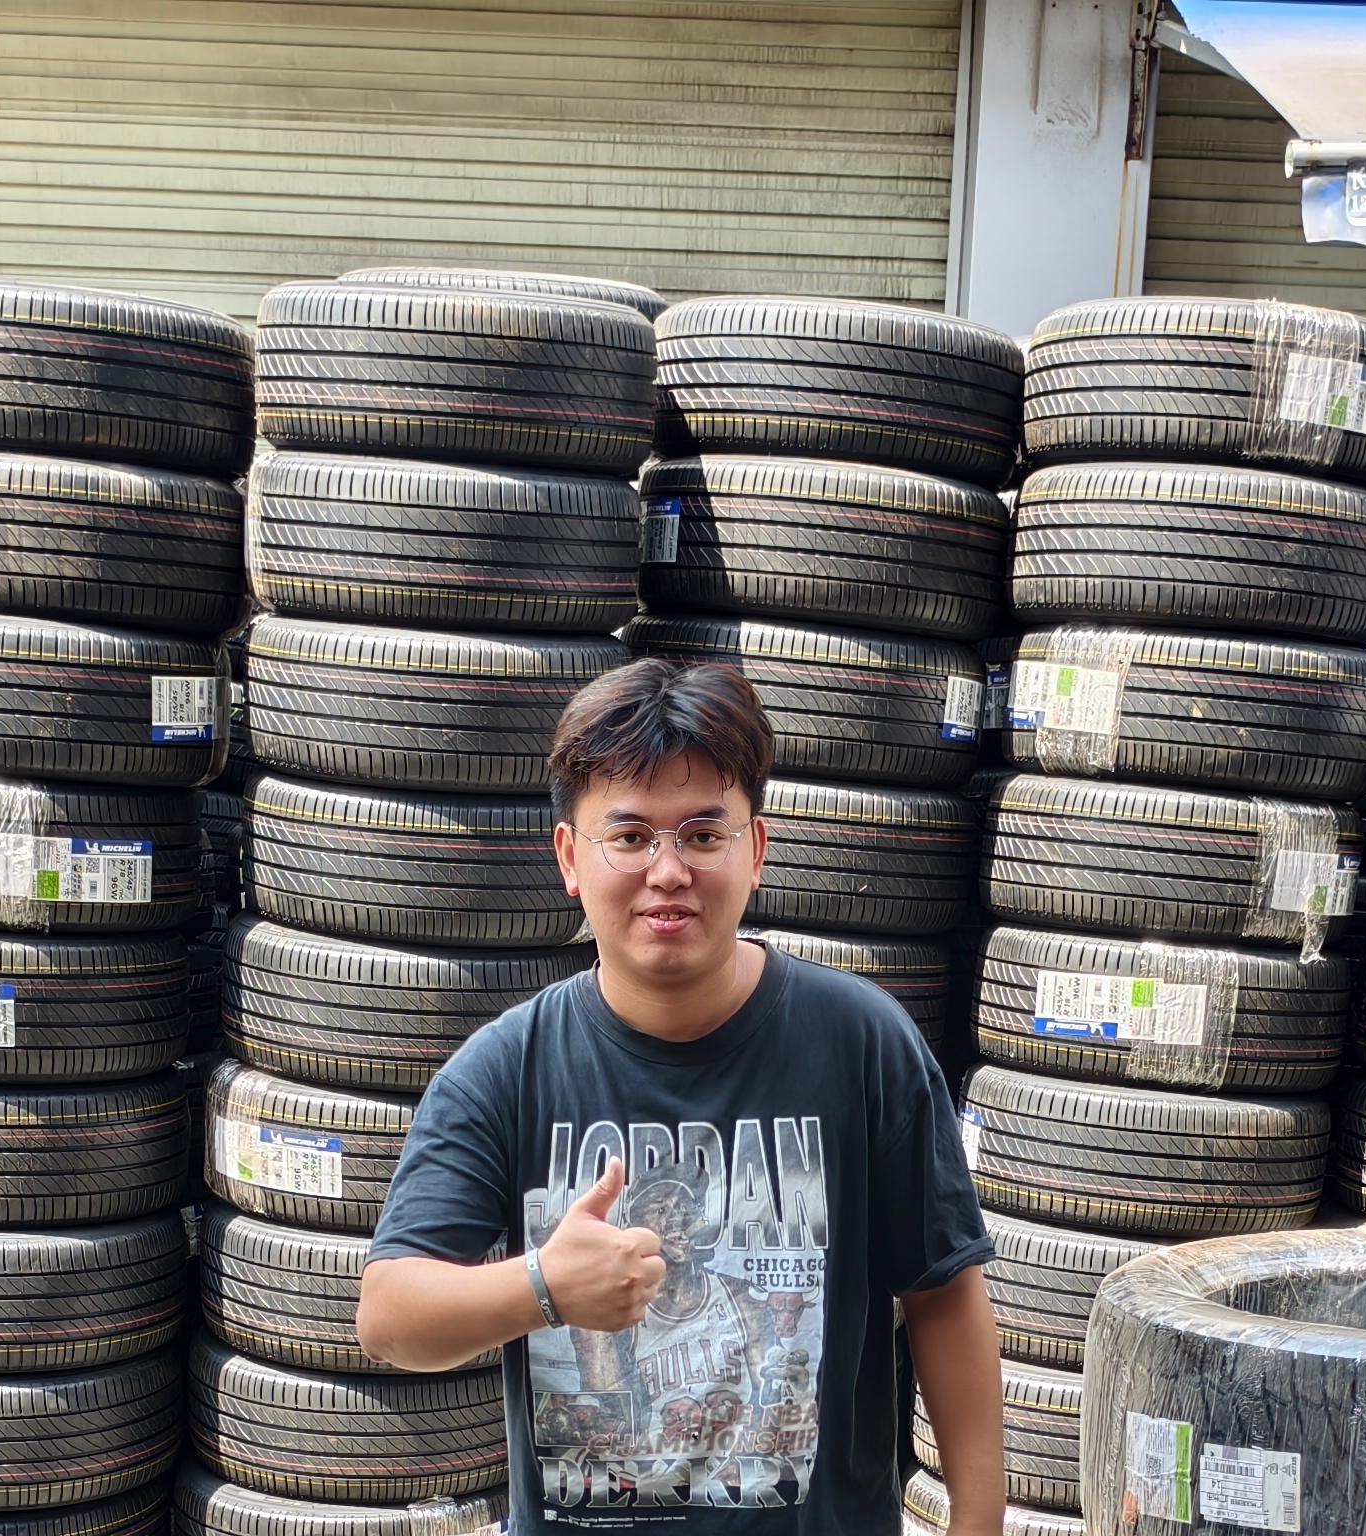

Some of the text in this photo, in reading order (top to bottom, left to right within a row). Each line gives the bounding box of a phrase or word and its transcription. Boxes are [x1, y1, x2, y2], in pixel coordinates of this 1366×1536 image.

[101, 844, 142, 853] MICHELIN
[743, 1258, 827, 1272] CHICAGO
[755, 1273, 815, 1288] BULLS
[638, 1339, 742, 1401] BULLS
[762, 1401, 819, 1427] NBA
